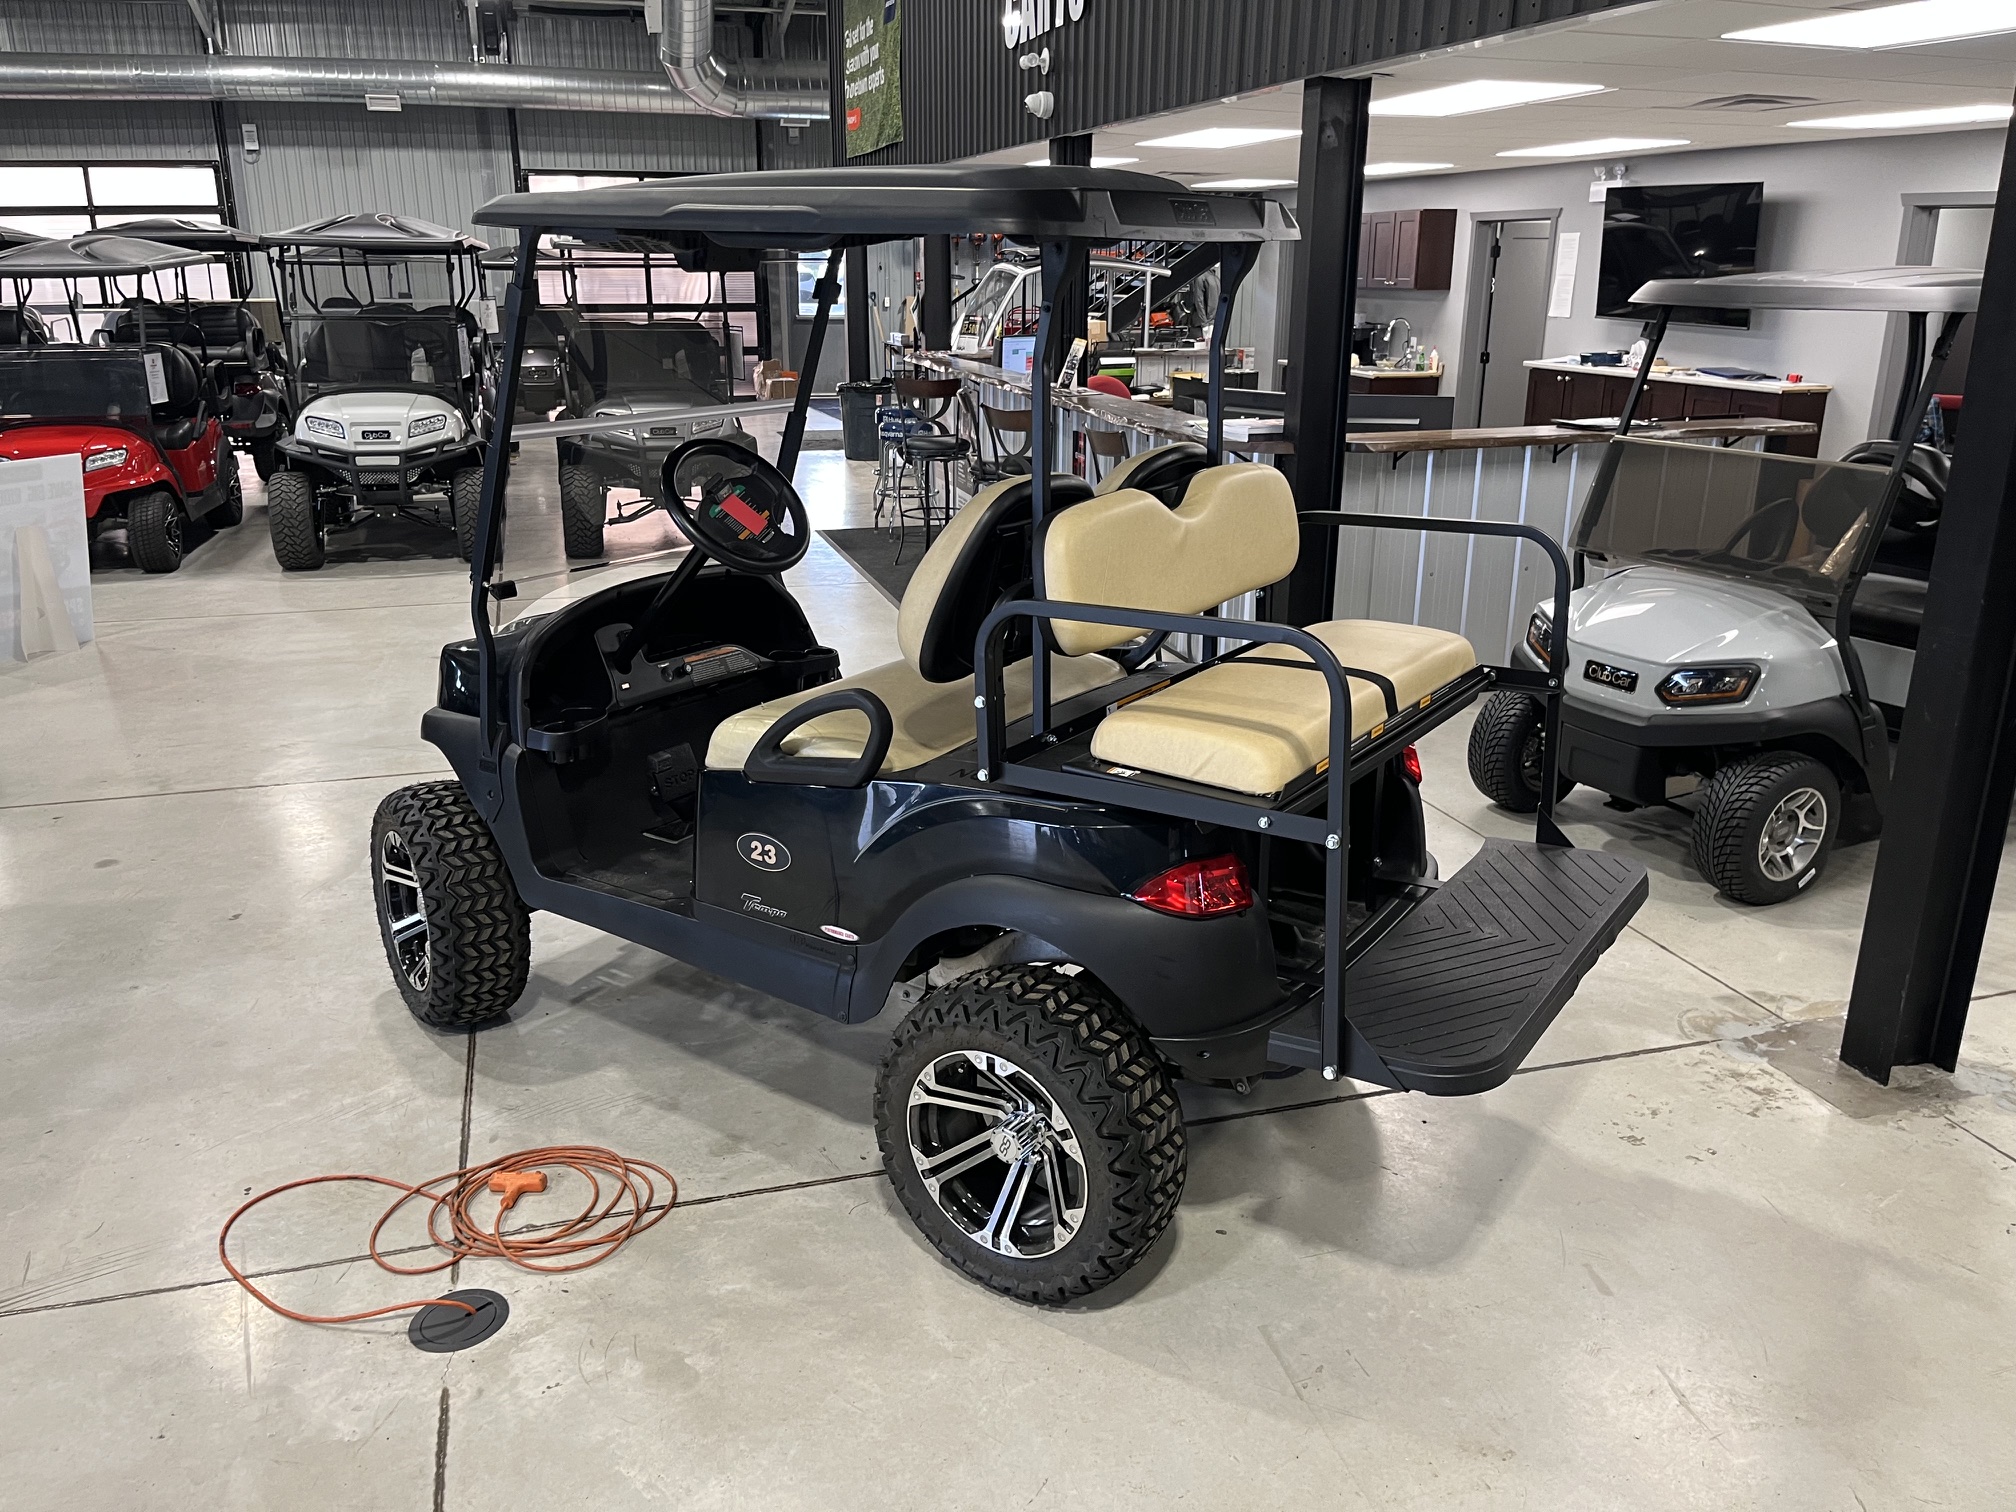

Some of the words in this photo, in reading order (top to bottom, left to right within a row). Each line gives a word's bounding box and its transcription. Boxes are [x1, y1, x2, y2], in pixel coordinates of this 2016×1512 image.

[1589, 665, 1612, 682] Club
[1612, 671, 1632, 687] Car
[750, 840, 777, 865] 23
[740, 892, 788, 918] Tempo
